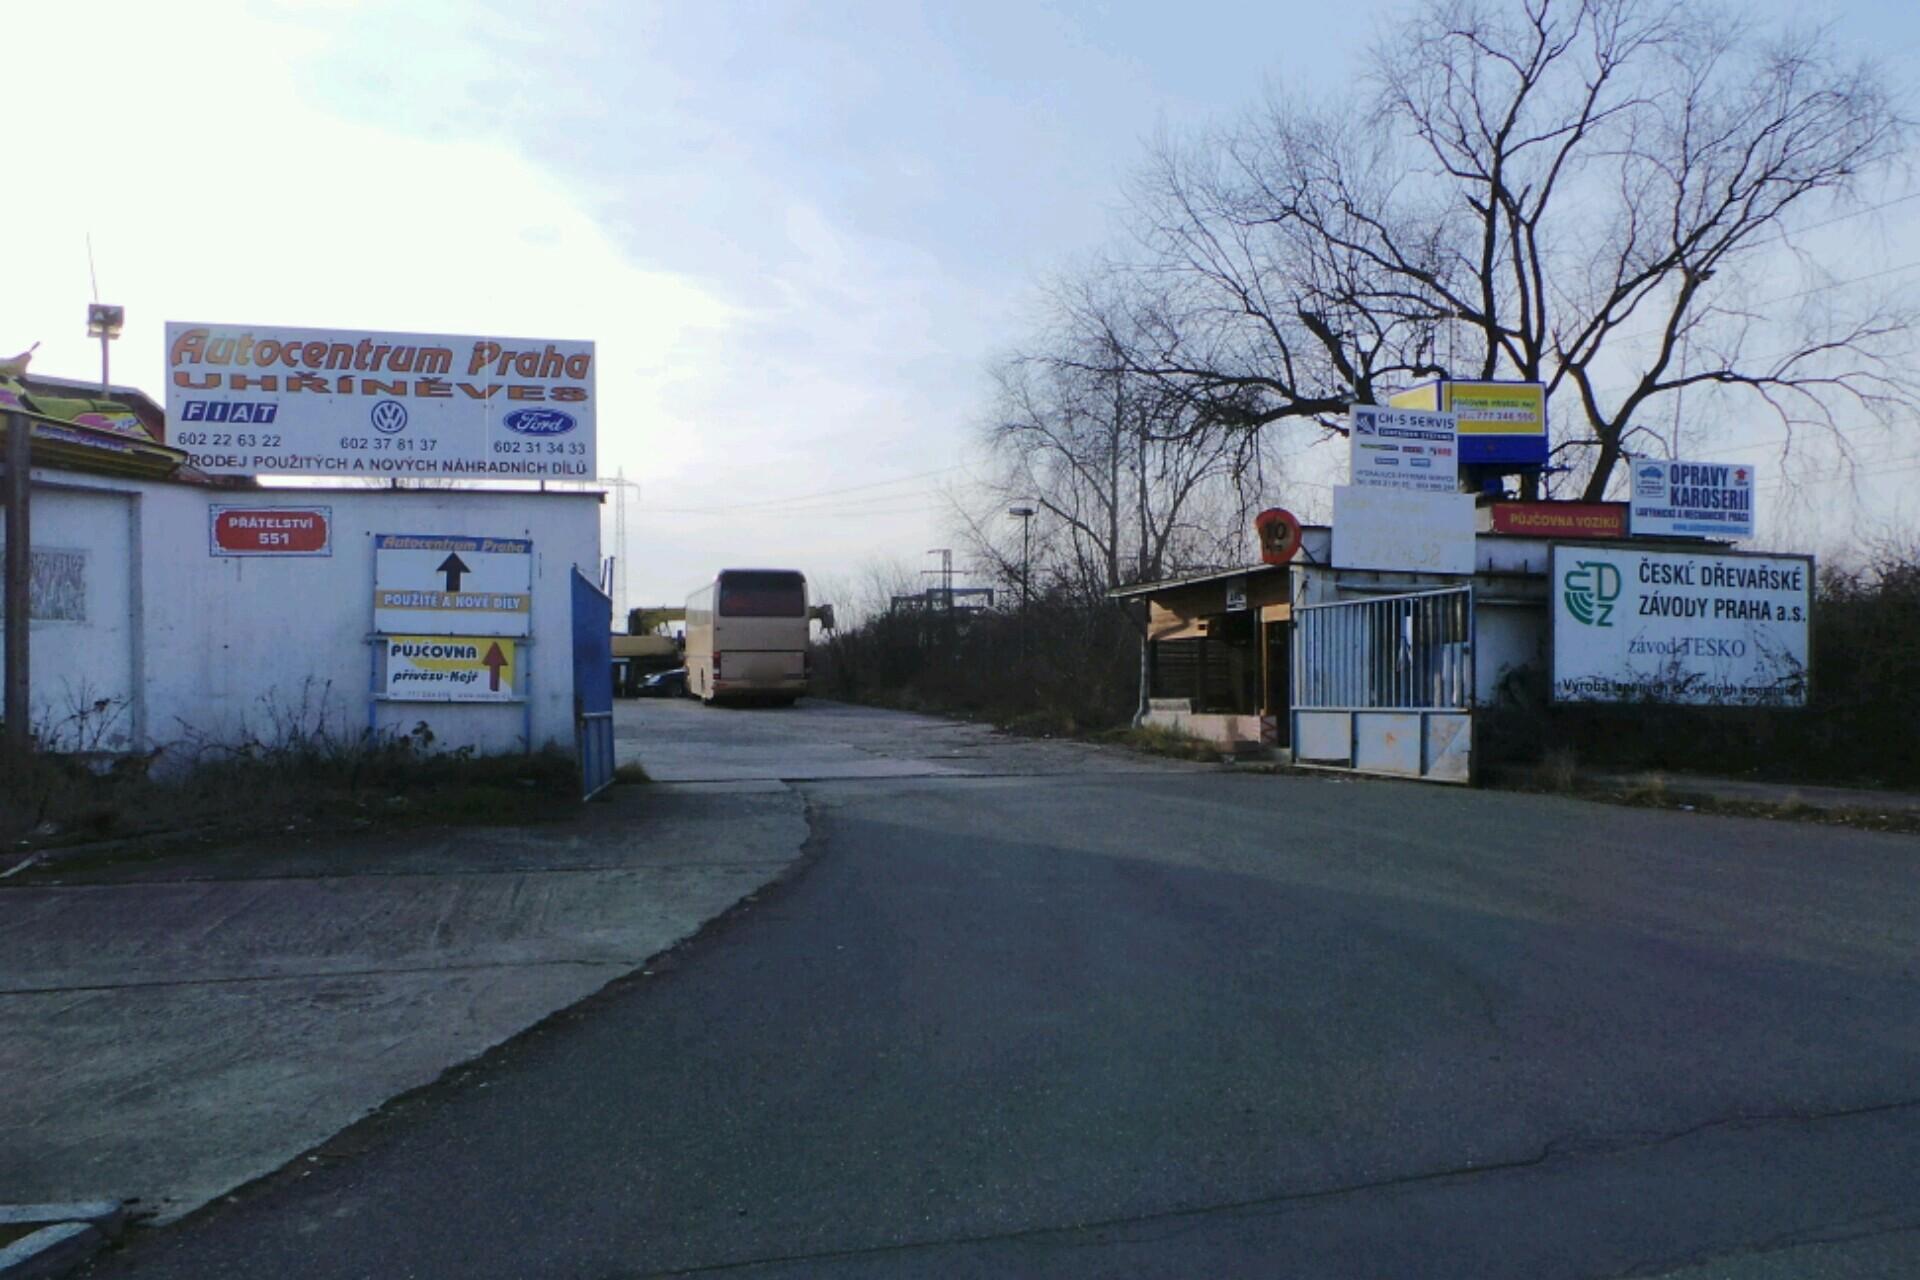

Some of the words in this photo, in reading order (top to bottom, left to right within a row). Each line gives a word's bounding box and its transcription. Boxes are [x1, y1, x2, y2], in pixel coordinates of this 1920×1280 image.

[171, 328, 453, 374] Autocentrum
[467, 341, 591, 379] Praha
[173, 371, 588, 402] UHŘÍNĚVES
[184, 402, 276, 422] FIAT
[516, 412, 563, 432] Ford
[1410, 415, 1455, 429] SERVIS
[178, 432, 207, 445] 602
[212, 433, 232, 446] 22
[238, 434, 256, 447] 63
[262, 435, 281, 447] 22
[340, 437, 368, 450] 602
[375, 438, 392, 450] 37
[397, 439, 414, 451] 81
[420, 439, 437, 451] 37
[494, 440, 520, 454] 602
[525, 441, 541, 454] 31
[547, 442, 564, 455] 34
[569, 442, 586, 455] 33
[253, 454, 347, 470] POUŽITÝCH
[353, 457, 364, 471] A
[370, 456, 437, 472] NOVÝCH
[442, 458, 548, 474] NÁHRADNÍCH
[552, 460, 587, 475] DÍLŮ
[1670, 464, 1729, 487] OPRAVY
[1670, 486, 1750, 510] KAROSERIÍ
[228, 516, 313, 529] PŘÁTELSTVÍ
[1511, 512, 1574, 527] PŮJČOVNA
[1576, 515, 1618, 528] VOZÍKŮ
[259, 532, 289, 544] 551
[383, 536, 477, 551] Autocentrum
[481, 539, 526, 553] Praha
[1701, 561, 1803, 591] DŘEVAŘSKÉ
[384, 592, 438, 607] POUŽITÉ
[442, 595, 451, 607] A
[455, 593, 489, 608] NOVÉ
[493, 594, 521, 609] DÍLY
[1714, 599, 1771, 621] PRAHA
[1777, 605, 1807, 622] a.s.
[390, 640, 477, 658] PŮJČOVNA
[1683, 636, 1746, 658] TESKO
